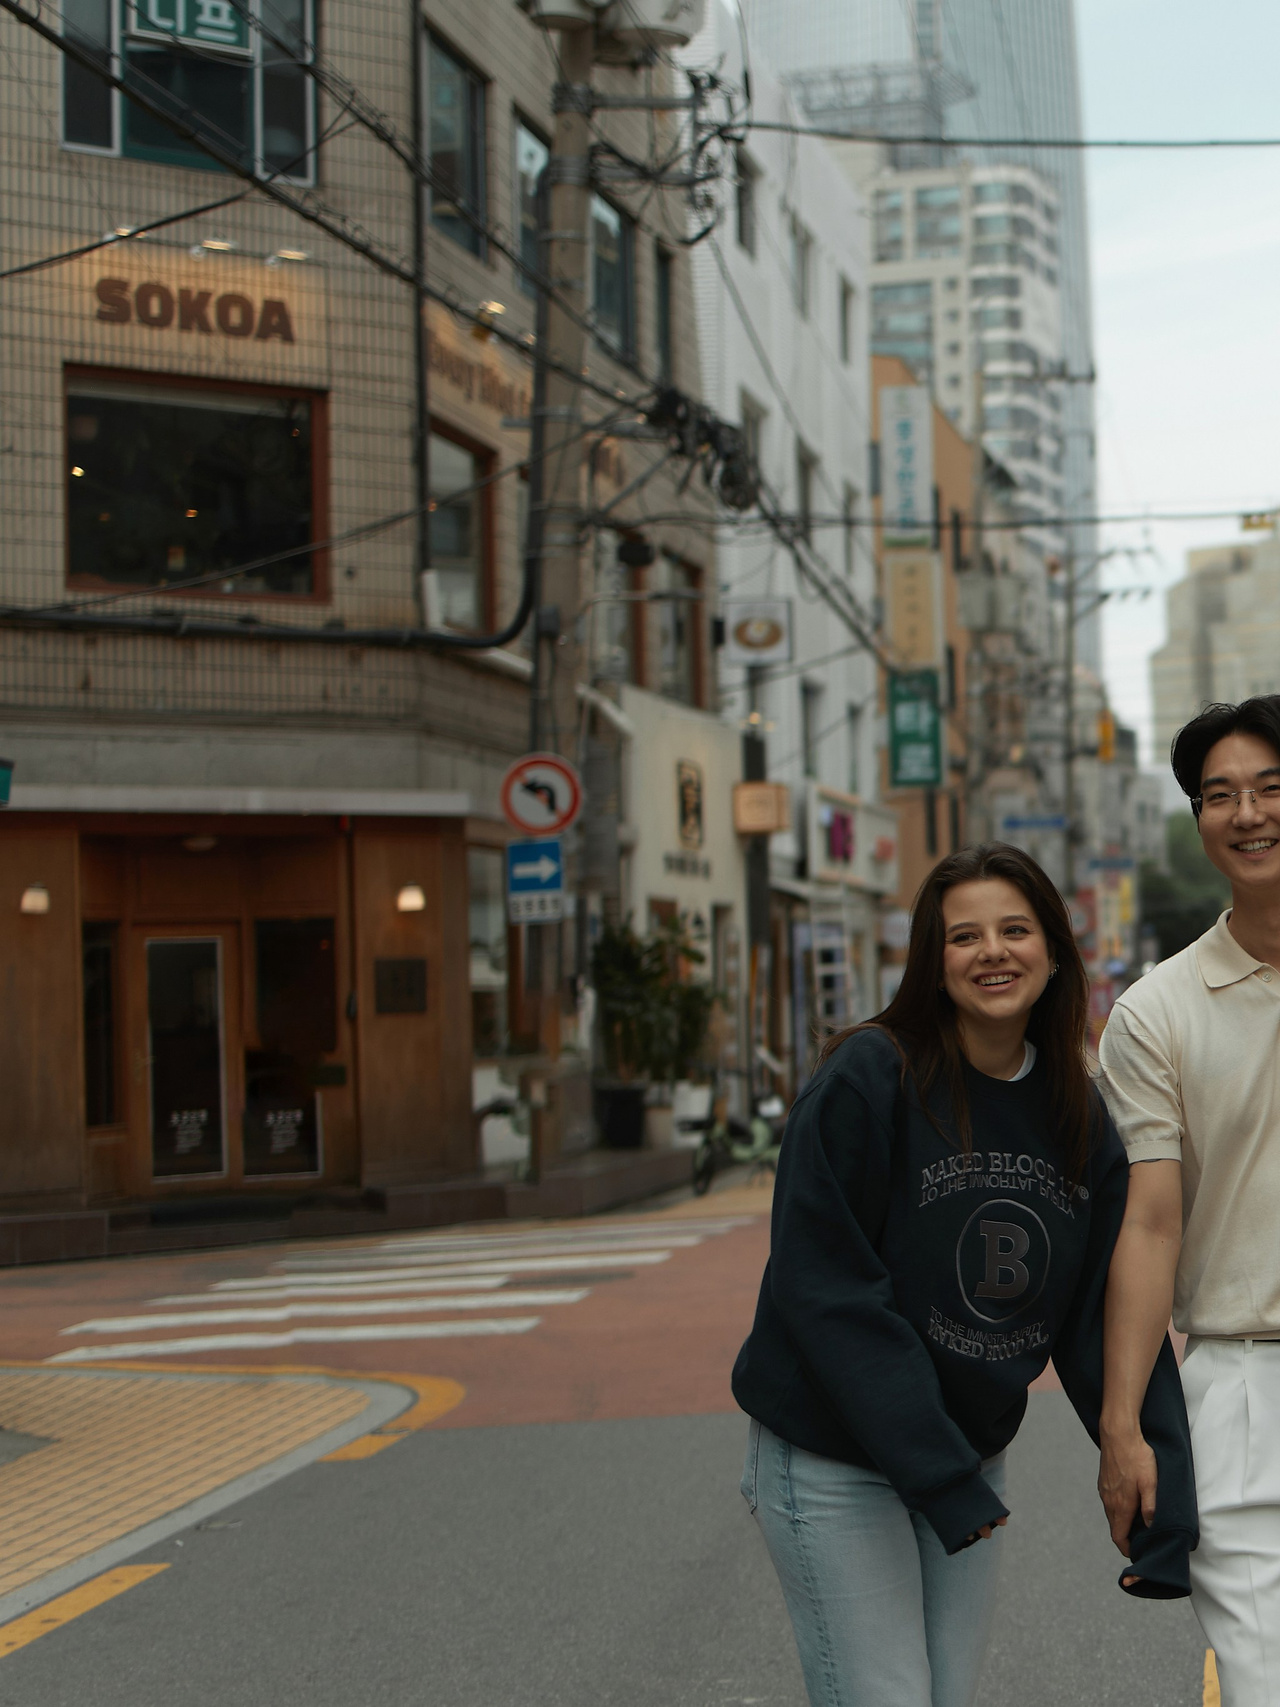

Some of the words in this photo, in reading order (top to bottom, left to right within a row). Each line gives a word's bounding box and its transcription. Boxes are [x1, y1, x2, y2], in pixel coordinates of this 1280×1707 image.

[94, 276, 296, 345] SOKOA
[921, 1152, 985, 1189] NAKED
[988, 1152, 1056, 1187] BLOOD
[974, 1219, 1030, 1298] B
[930, 1305, 943, 1323] TO
[944, 1316, 966, 1336] THE
[967, 1327, 1010, 1345] IMMORTAL
